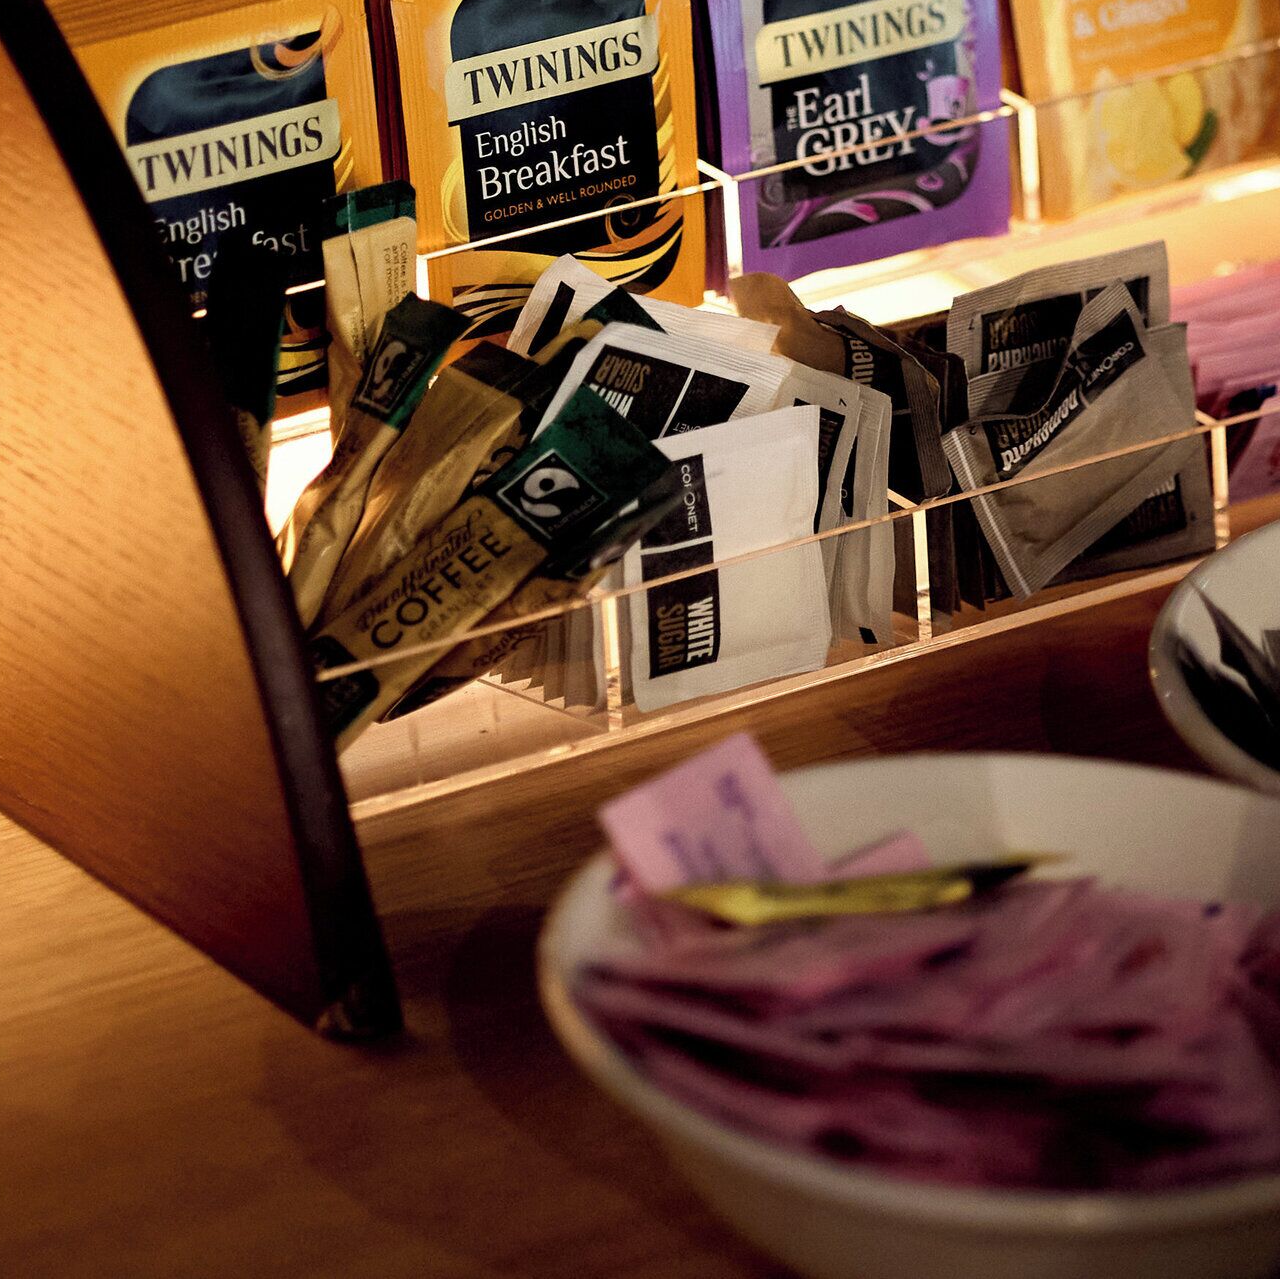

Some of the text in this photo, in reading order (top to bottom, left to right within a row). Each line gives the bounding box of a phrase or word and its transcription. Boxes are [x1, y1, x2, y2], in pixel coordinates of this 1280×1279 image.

[774, 0, 947, 68] TWININGS
[464, 31, 642, 106] TWININGS
[794, 74, 873, 129] Earl
[138, 115, 323, 192] TWININGS
[475, 115, 567, 159] English
[478, 134, 631, 200] Breakfast
[796, 106, 918, 177] GREY
[484, 174, 637, 222] GOLDEN & WELL ROUNDED
[595, 354, 651, 392] SUGAR
[371, 531, 512, 649] COFFEE
[656, 604, 685, 668] SUGAR
[687, 596, 715, 663] WHITE
